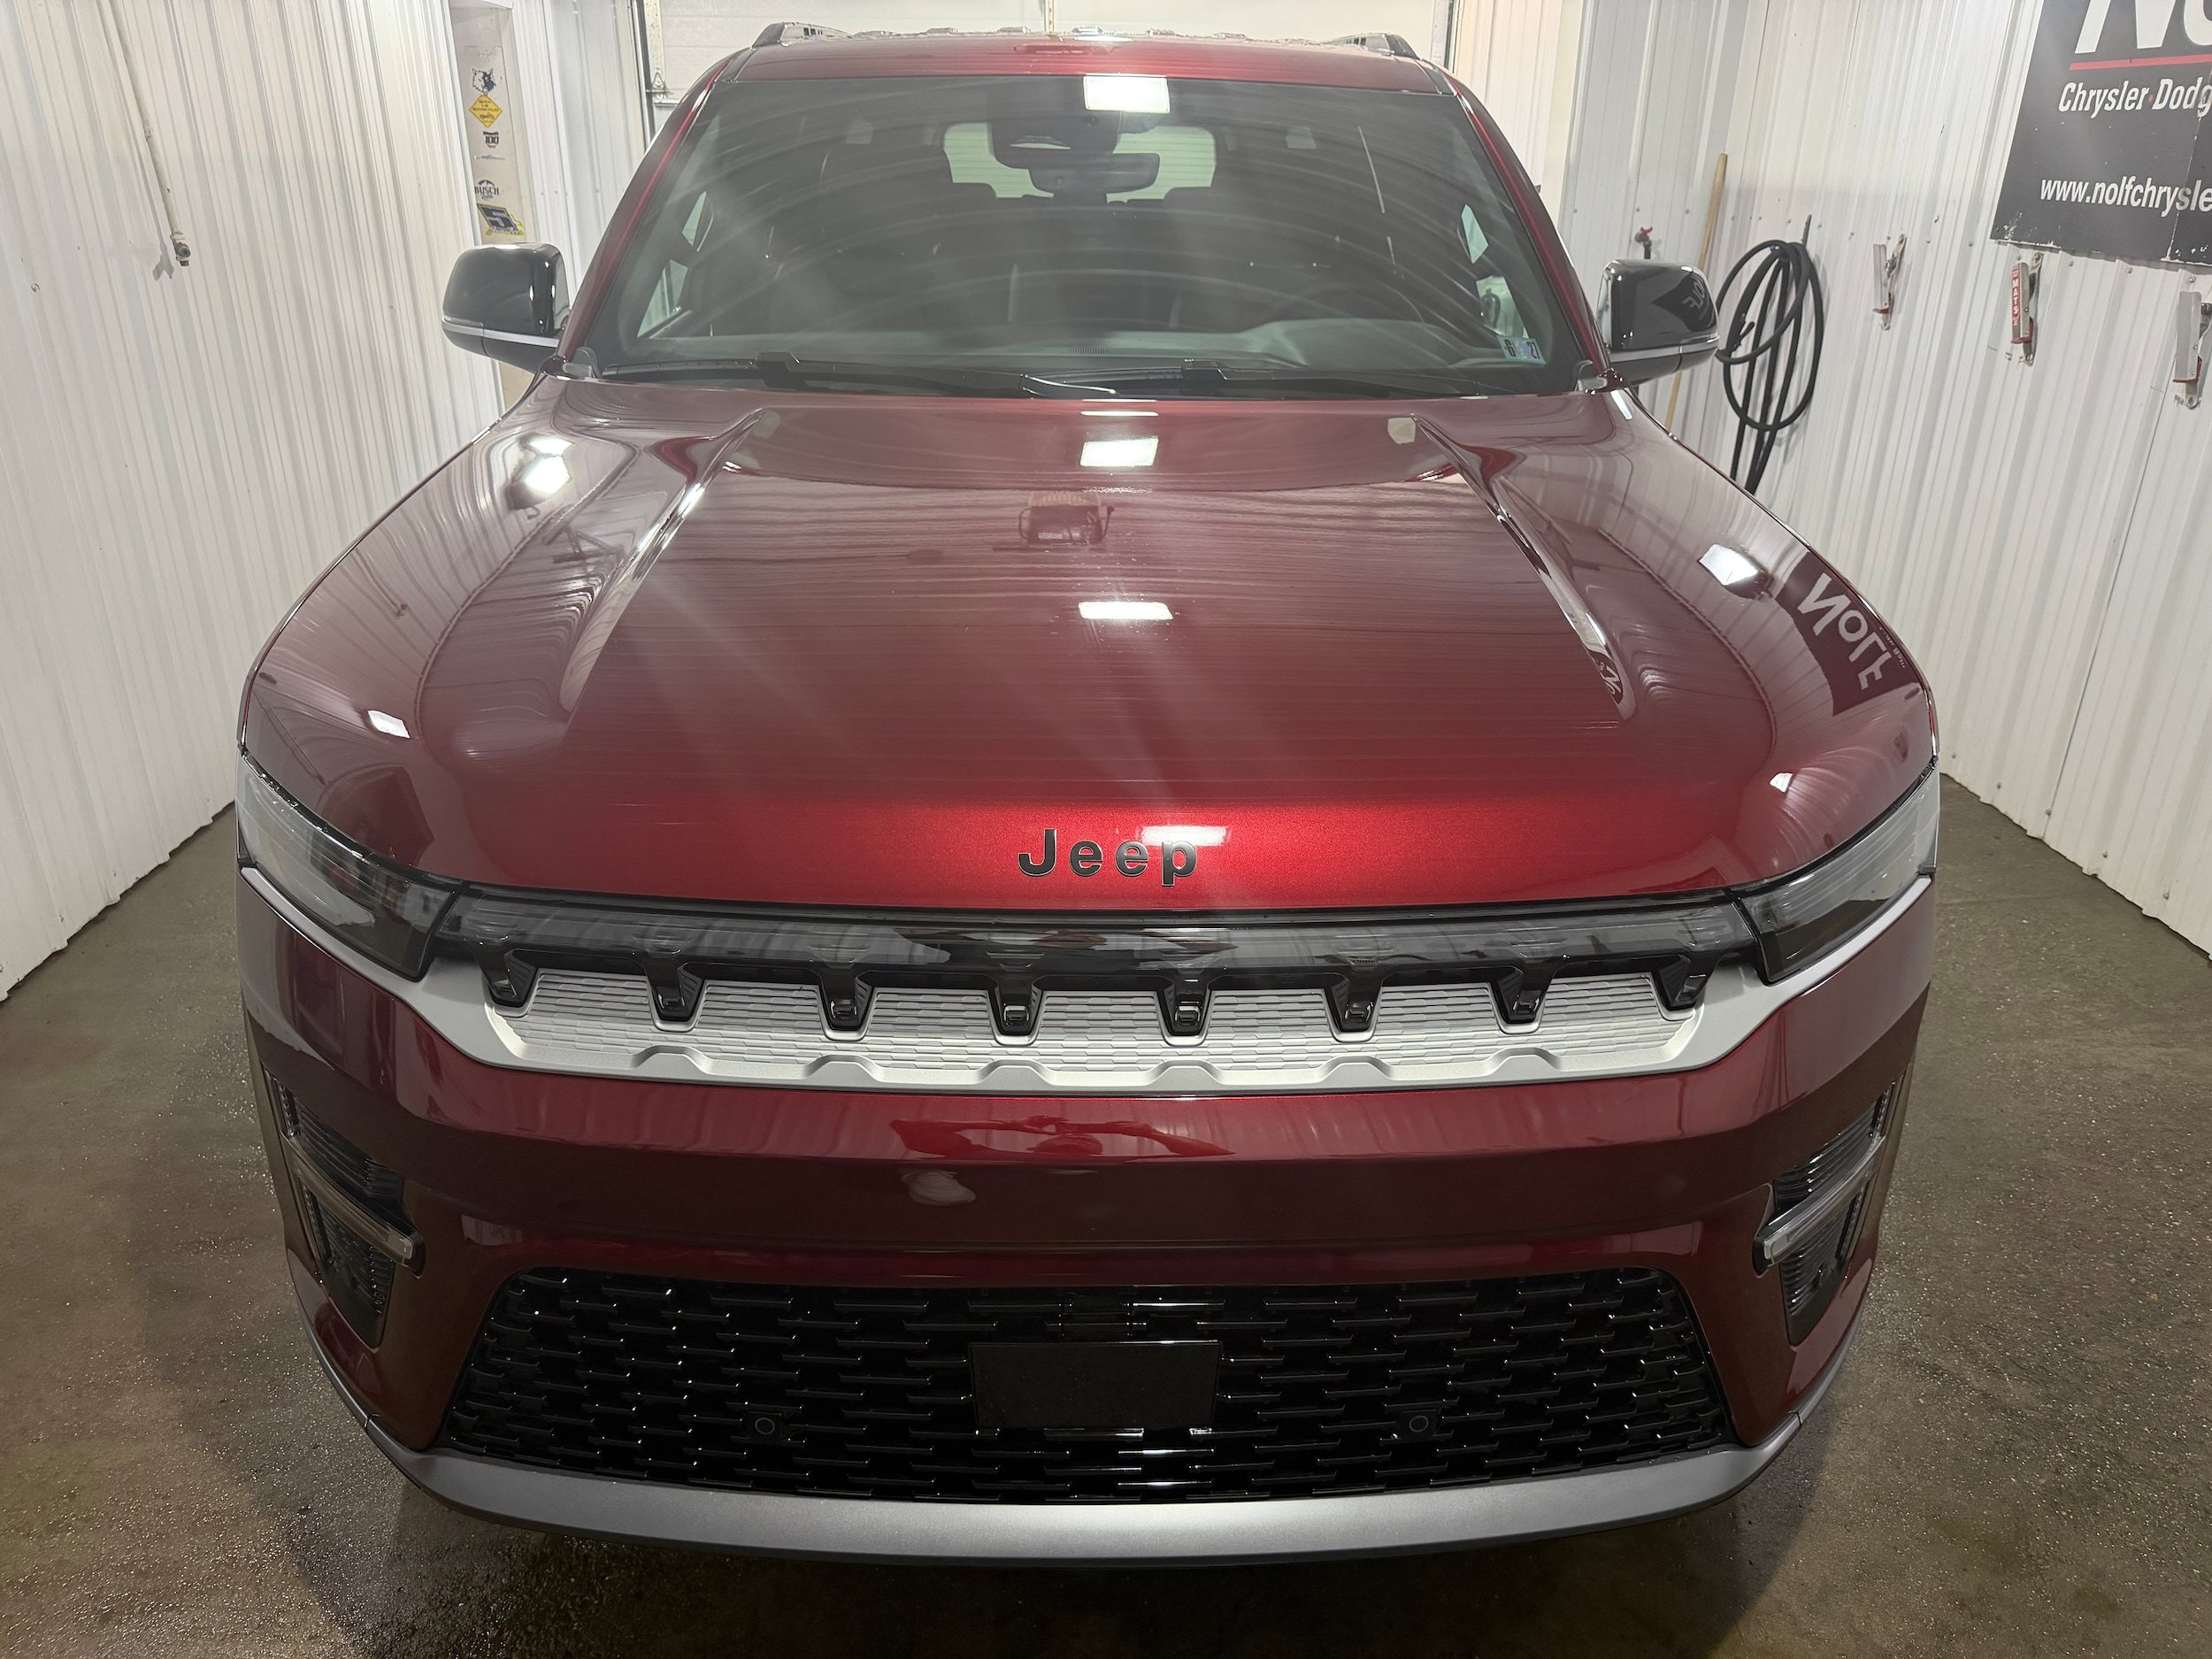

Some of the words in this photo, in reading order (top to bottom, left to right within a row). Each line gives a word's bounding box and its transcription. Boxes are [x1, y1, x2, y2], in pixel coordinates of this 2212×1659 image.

[2058, 79, 2148, 119] Chrysler
[474, 186, 500, 196] BUSCH
[2039, 175, 2212, 218] www.nolfchrysle
[1526, 341, 1540, 360] 27
[1018, 828, 1197, 887] Jeep
